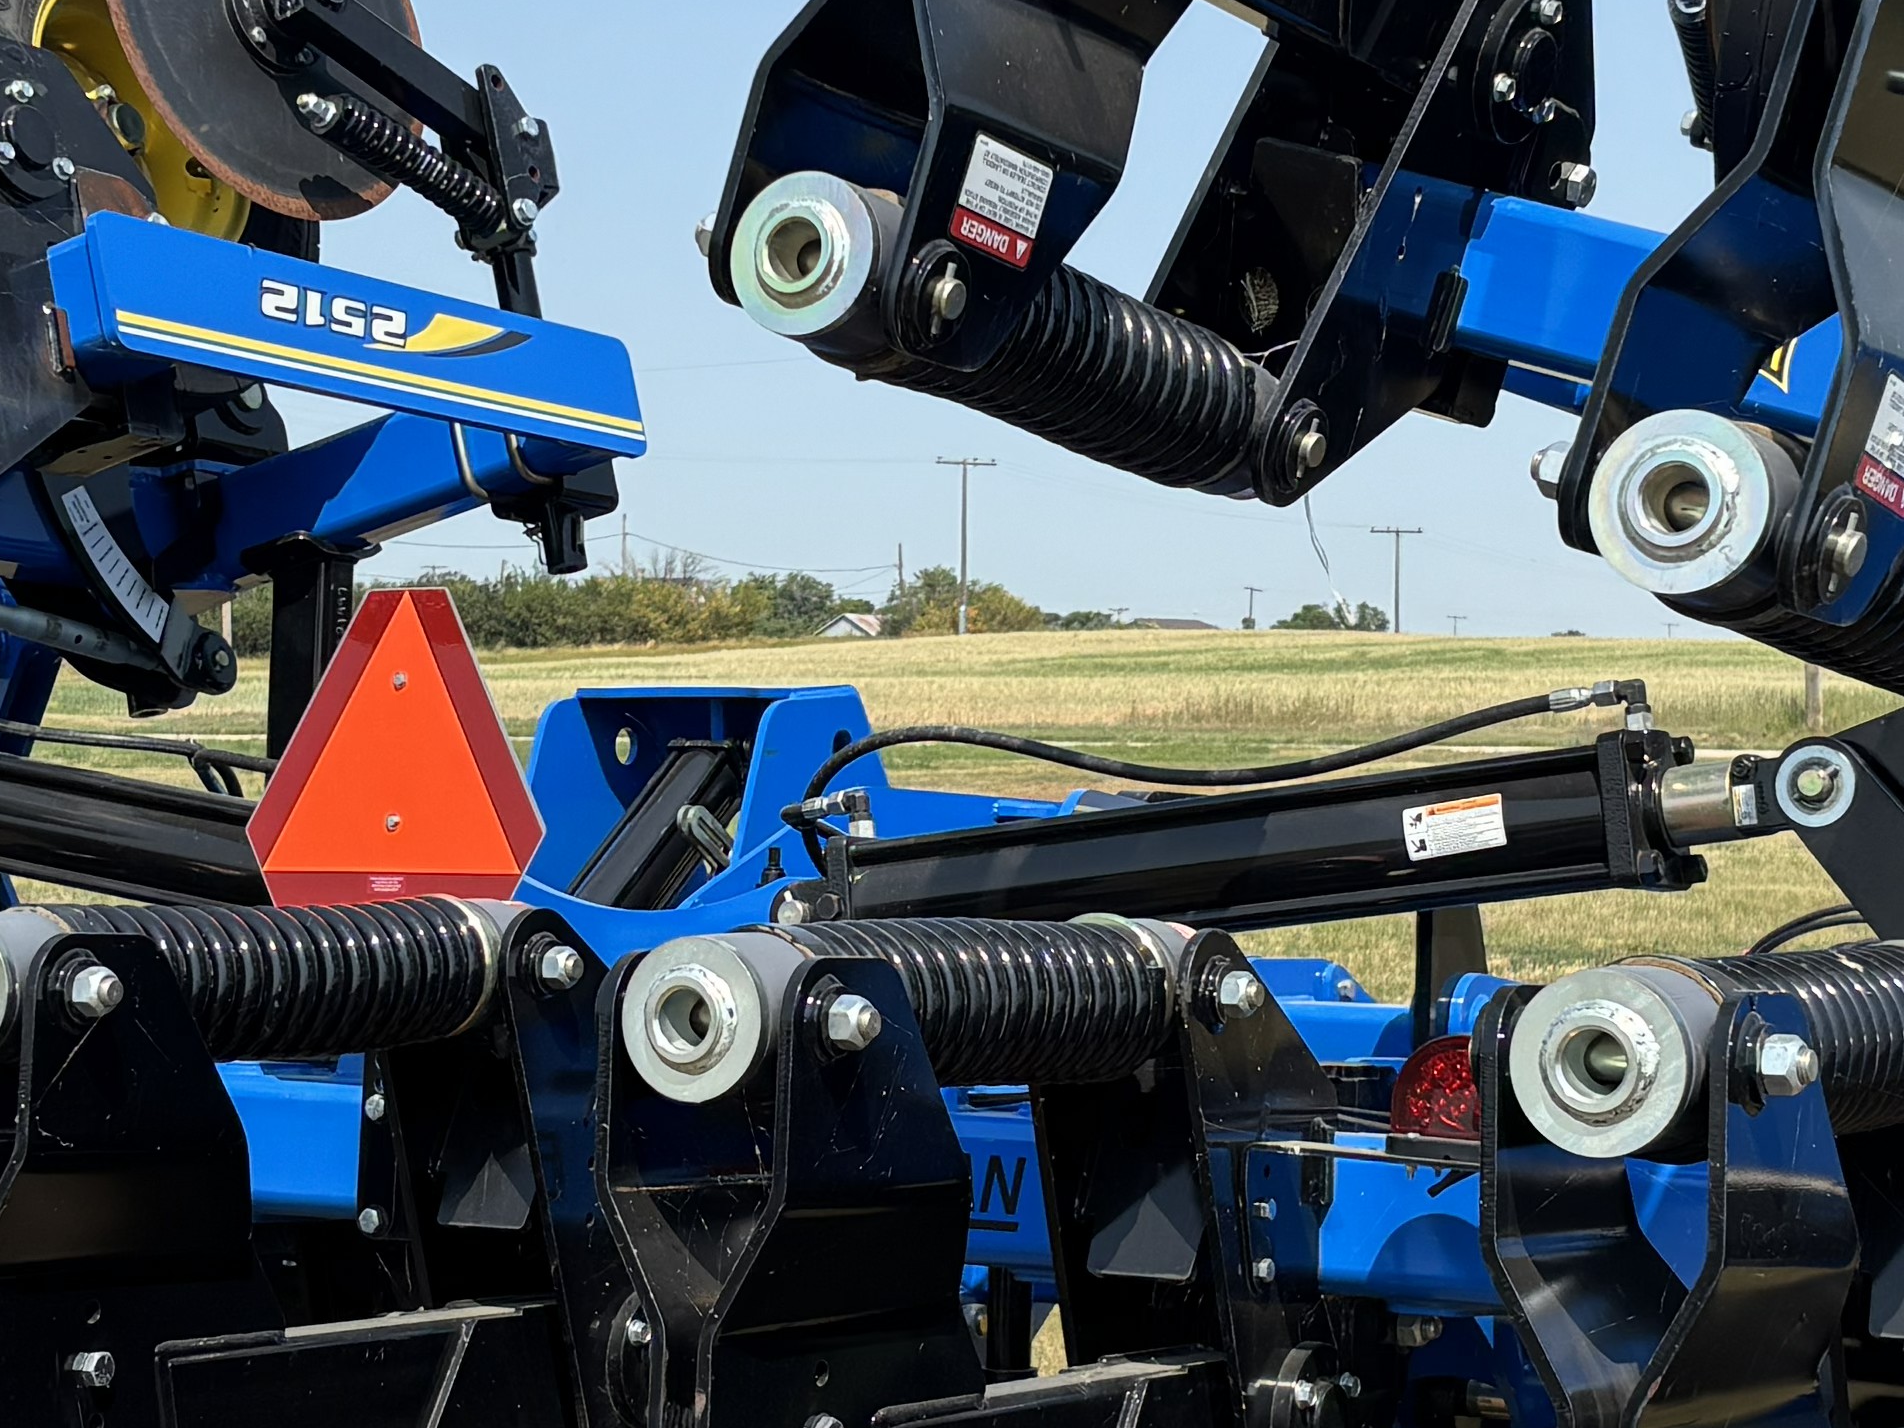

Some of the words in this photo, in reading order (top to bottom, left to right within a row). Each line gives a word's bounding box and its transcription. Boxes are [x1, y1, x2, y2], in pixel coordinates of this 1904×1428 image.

[960, 216, 1010, 254] DANGER
[261, 278, 408, 350] 2512
[1862, 465, 1898, 503] DANGER
